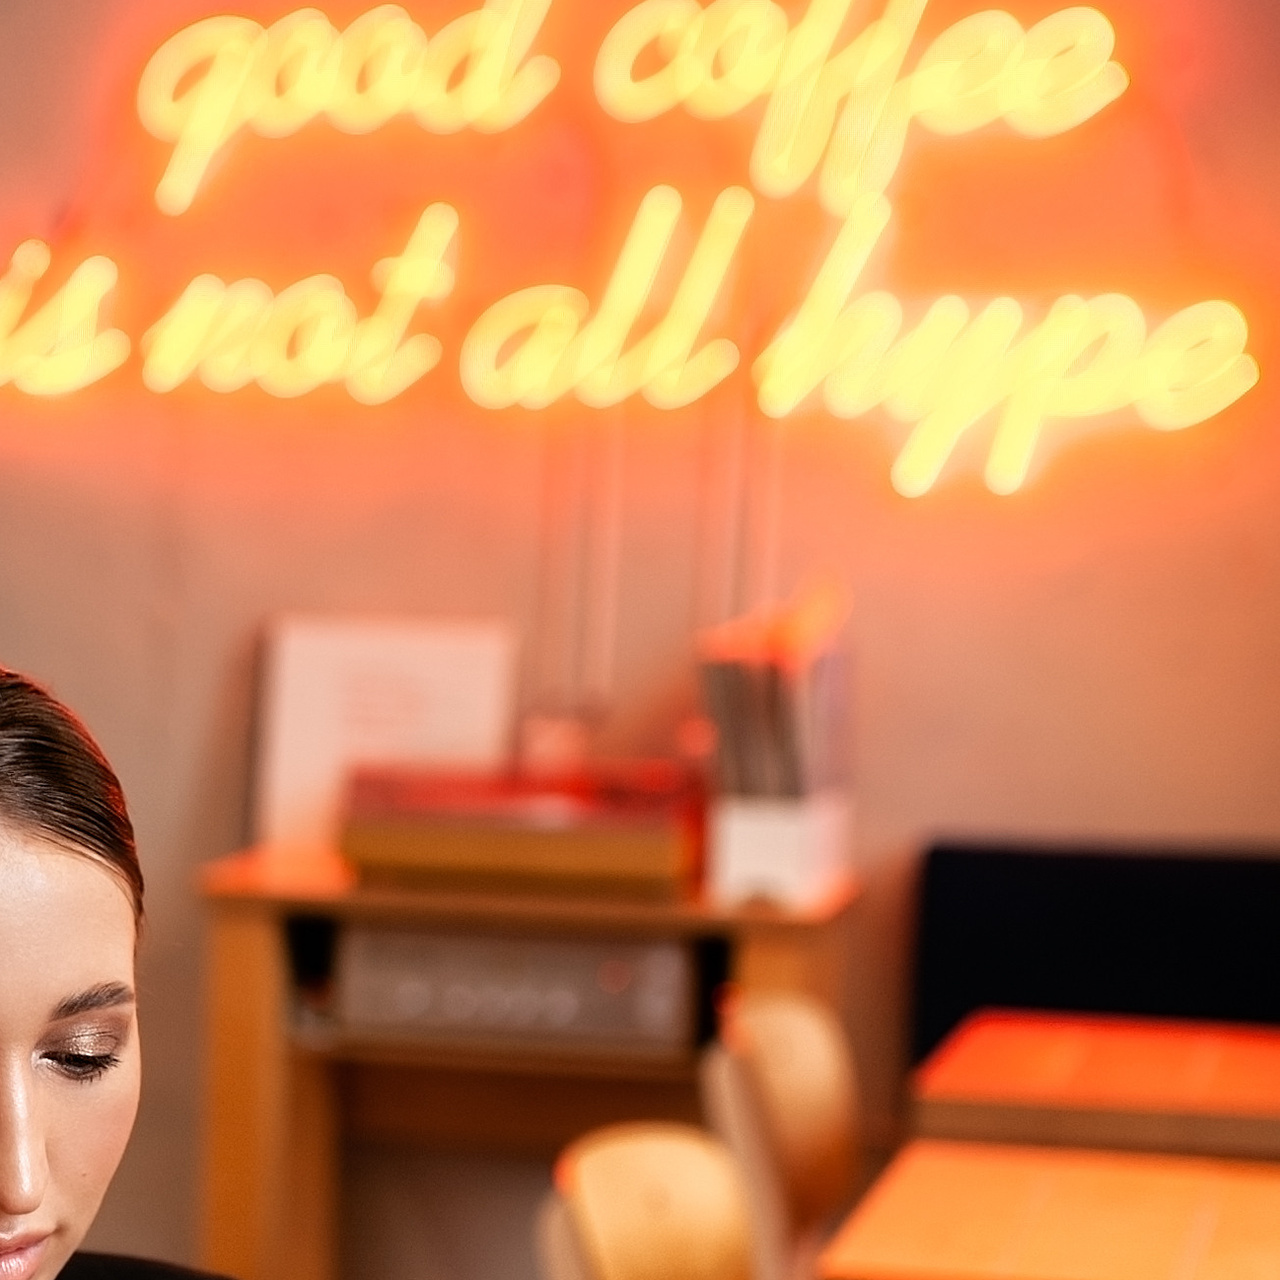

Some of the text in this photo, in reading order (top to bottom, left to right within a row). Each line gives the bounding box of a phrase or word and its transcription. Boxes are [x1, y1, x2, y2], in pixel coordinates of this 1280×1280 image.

[137, 0, 1129, 218] good coffee
[142, 202, 455, 405] not
[460, 184, 754, 410] all
[754, 192, 1260, 497] hype
